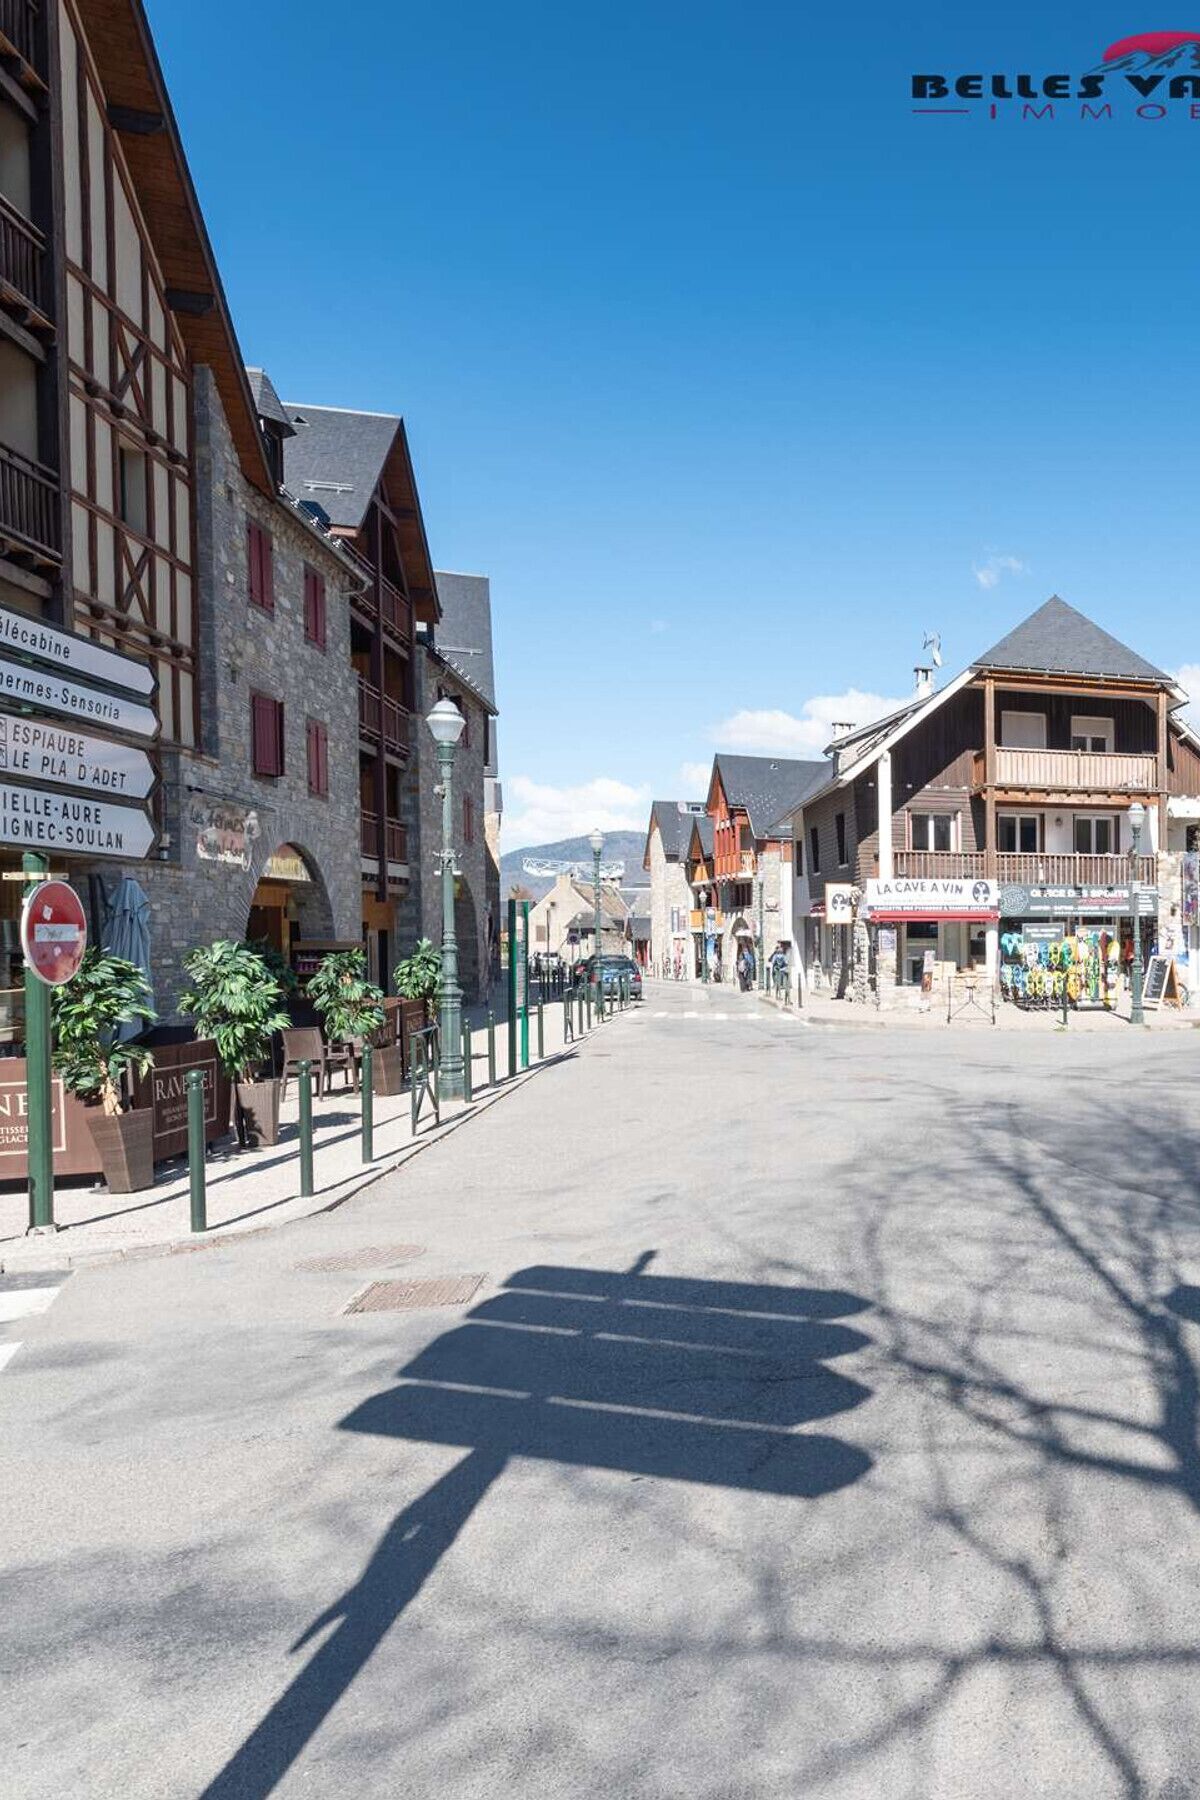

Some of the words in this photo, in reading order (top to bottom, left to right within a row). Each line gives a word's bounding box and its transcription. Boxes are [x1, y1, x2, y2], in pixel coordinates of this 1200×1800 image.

[12, 723, 86, 758] ESPIAUBE
[13, 749, 30, 769] LE
[41, 756, 67, 778] PLA
[77, 764, 127, 789] D'ADET
[876, 882, 892, 896] LA
[895, 881, 927, 893] CAVE
[930, 882, 940, 892] A
[941, 882, 964, 895] VIN
[155, 1069, 214, 1102] RAVEEL
